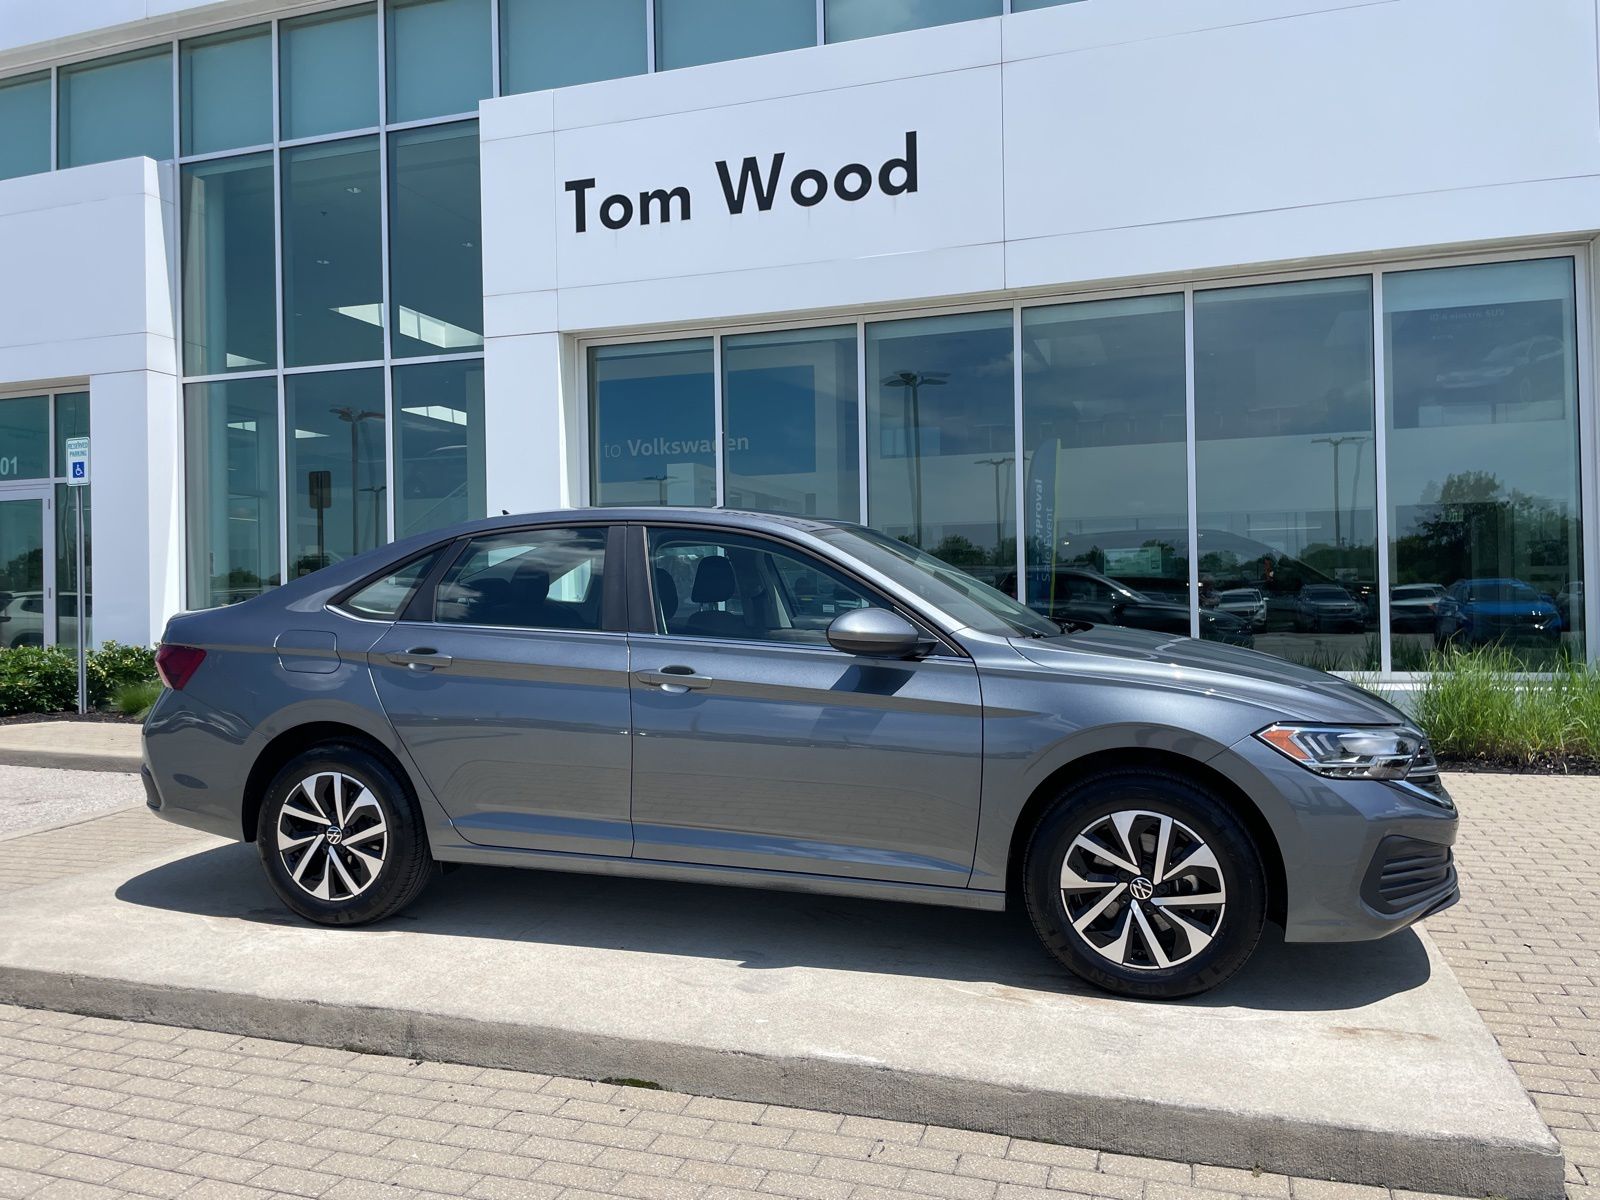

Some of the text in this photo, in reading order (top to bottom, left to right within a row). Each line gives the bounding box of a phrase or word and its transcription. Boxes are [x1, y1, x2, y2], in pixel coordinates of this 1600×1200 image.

[564, 130, 918, 233] Tom Wood
[604, 441, 622, 458] to
